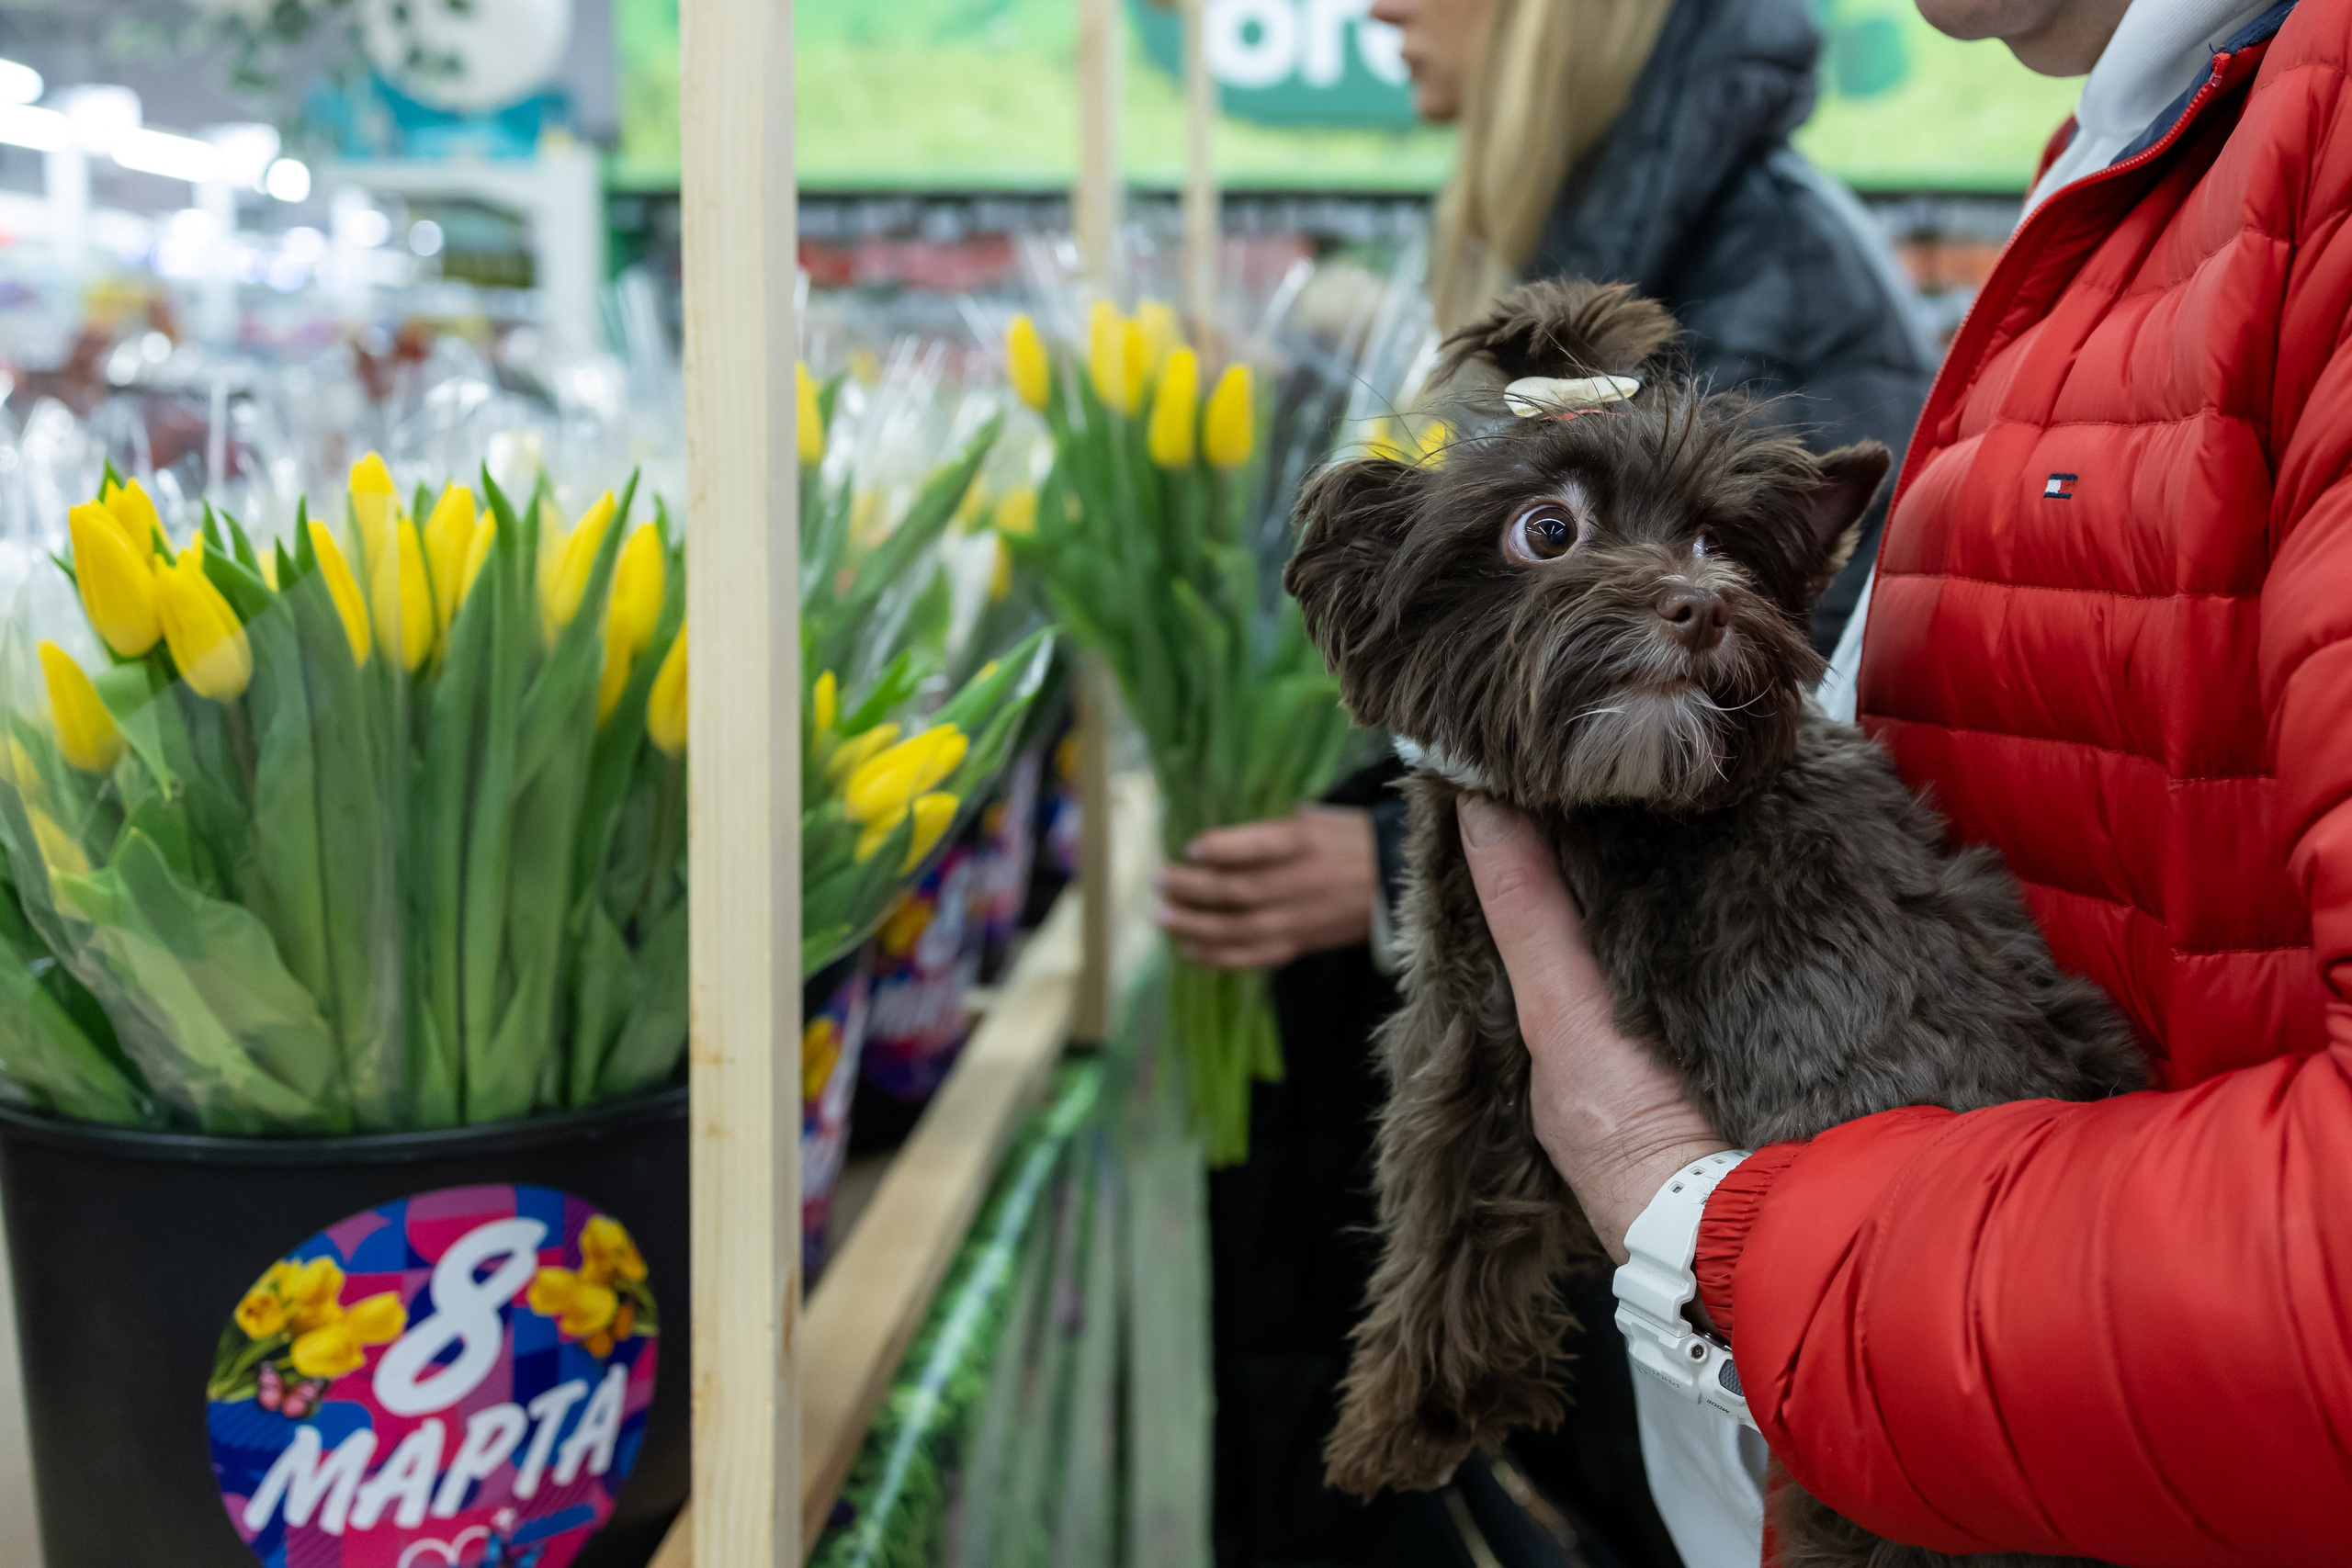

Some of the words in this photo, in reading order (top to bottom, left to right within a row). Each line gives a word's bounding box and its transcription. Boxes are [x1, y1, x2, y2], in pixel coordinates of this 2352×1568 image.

[373, 1217, 548, 1416] 8
[243, 1363, 628, 1535] МАРТА
[1706, 1399, 1730, 1414] MODE
